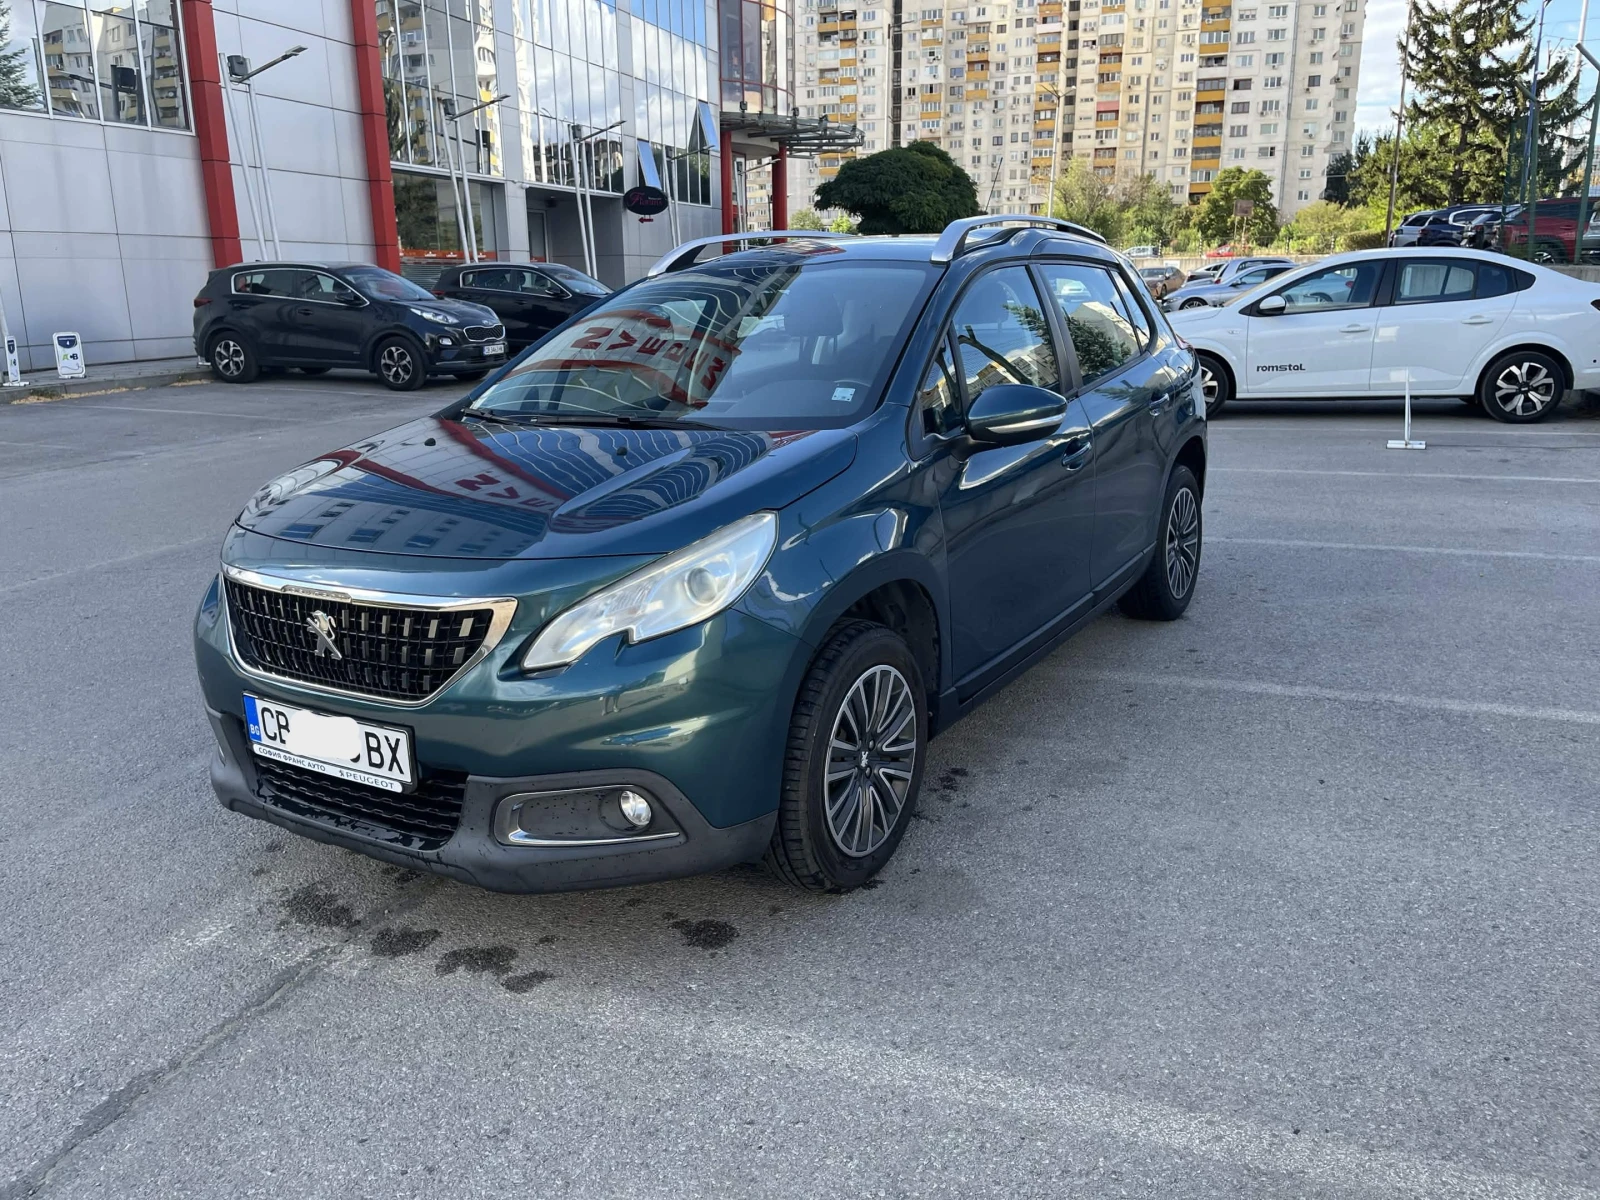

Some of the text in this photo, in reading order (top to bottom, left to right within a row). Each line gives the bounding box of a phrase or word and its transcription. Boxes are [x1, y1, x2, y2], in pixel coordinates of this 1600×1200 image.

[1256, 363, 1306, 372] romstal
[250, 723, 260, 736] BG
[258, 747, 326, 772] СОФИЯ ФРАНС АУТО
[364, 731, 404, 775] BX
[346, 771, 395, 789] PEUGEOT
